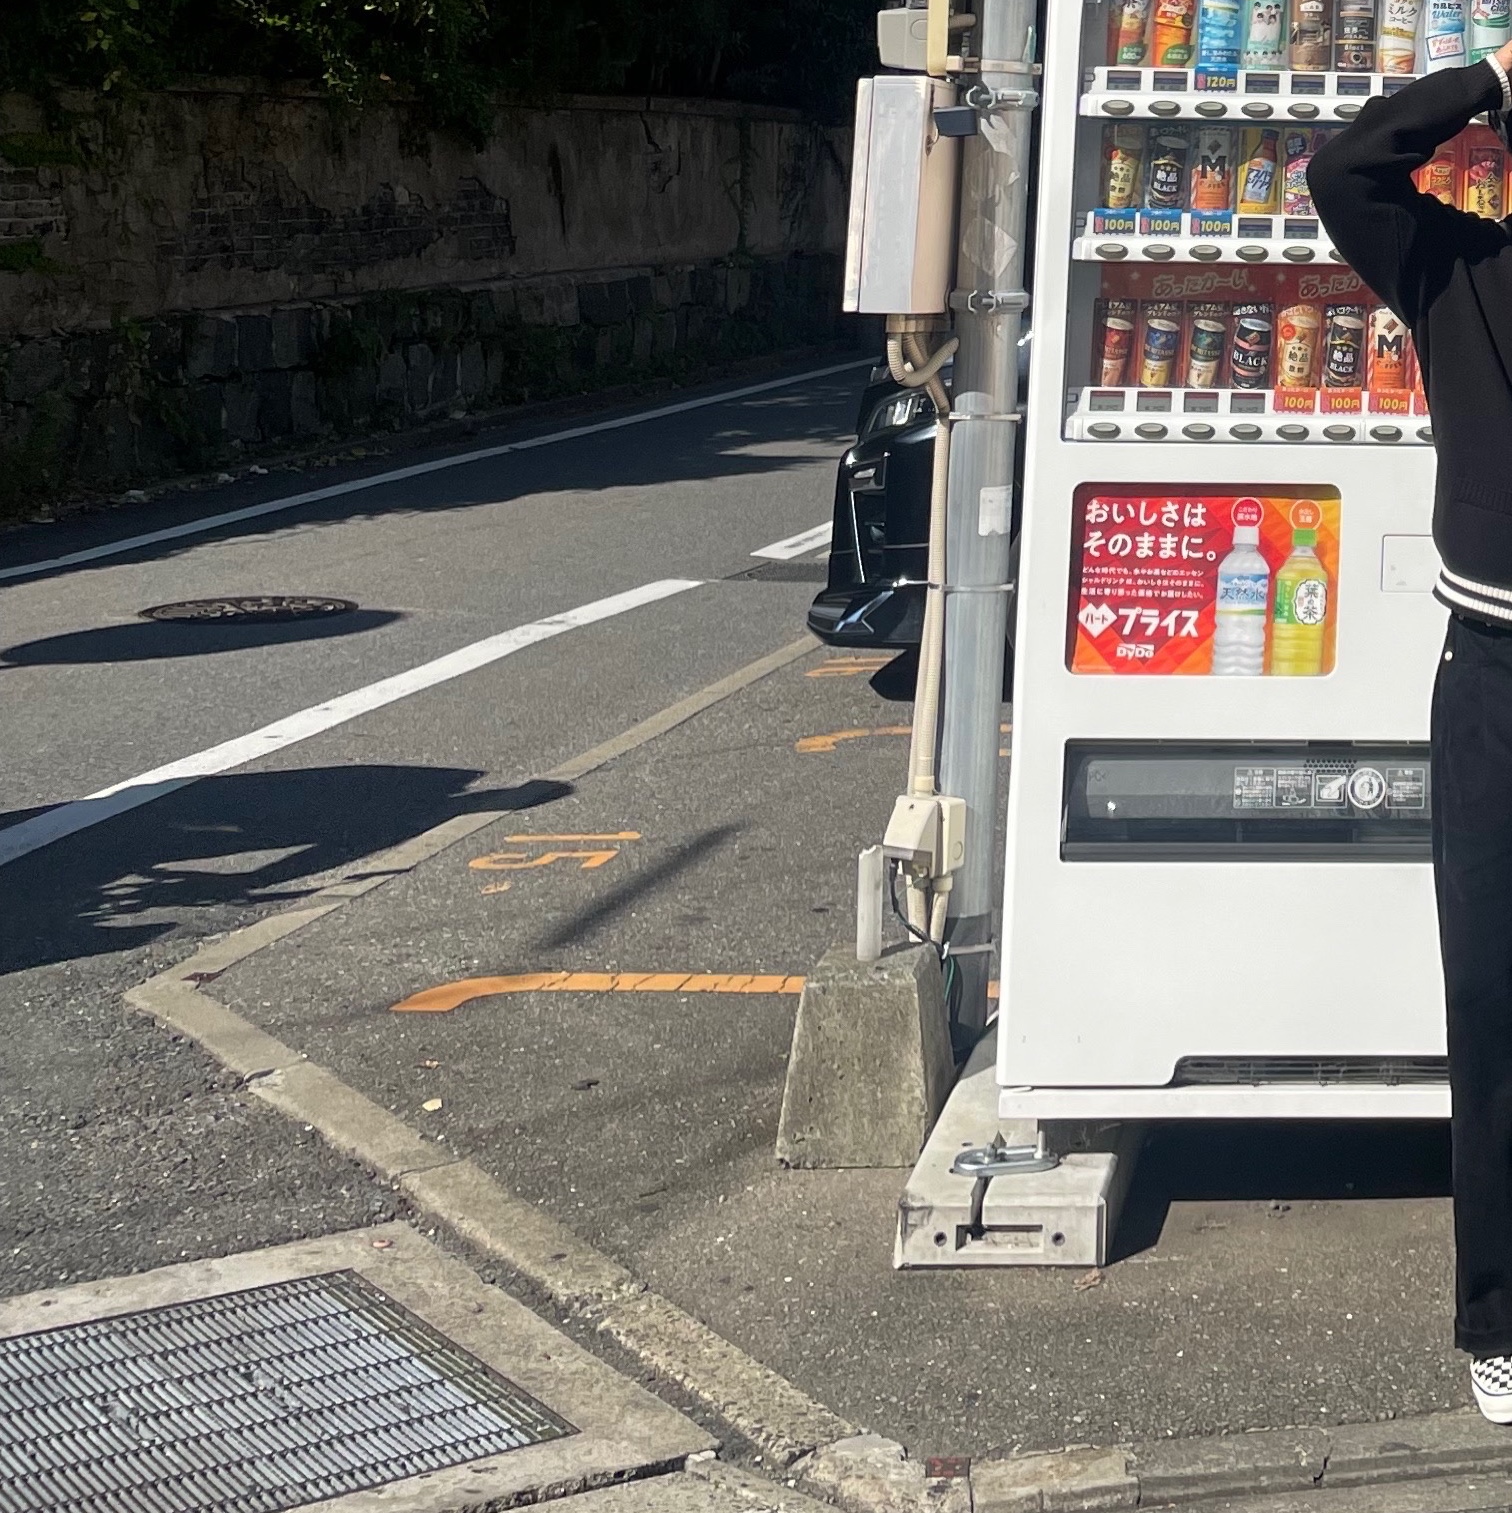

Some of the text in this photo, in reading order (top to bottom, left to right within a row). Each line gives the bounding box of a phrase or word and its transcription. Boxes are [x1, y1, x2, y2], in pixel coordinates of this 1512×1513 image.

[1388, 3, 1418, 17] ミルク
[1432, 8, 1462, 19] Water
[1389, 16, 1413, 25] コーヒー
[1206, 76, 1236, 88] 120円
[1153, 182, 1178, 192] BLACK
[1104, 219, 1133, 231] 100円
[1150, 219, 1180, 232] 100円
[1200, 220, 1231, 232] 100円
[1233, 349, 1269, 366] BLACK
[1329, 364, 1354, 374] BLACK
[1284, 397, 1314, 410] 100円
[1330, 398, 1360, 410] 100円
[1379, 397, 1409, 411] 100円
[1085, 500, 1207, 527] おいしさは
[1083, 531, 1217, 561] そのままに。
[1220, 588, 1266, 601] 天然水
[1085, 613, 1109, 625] ハート
[1118, 607, 1200, 638] プライス
[1116, 644, 1155, 660] DyDo
